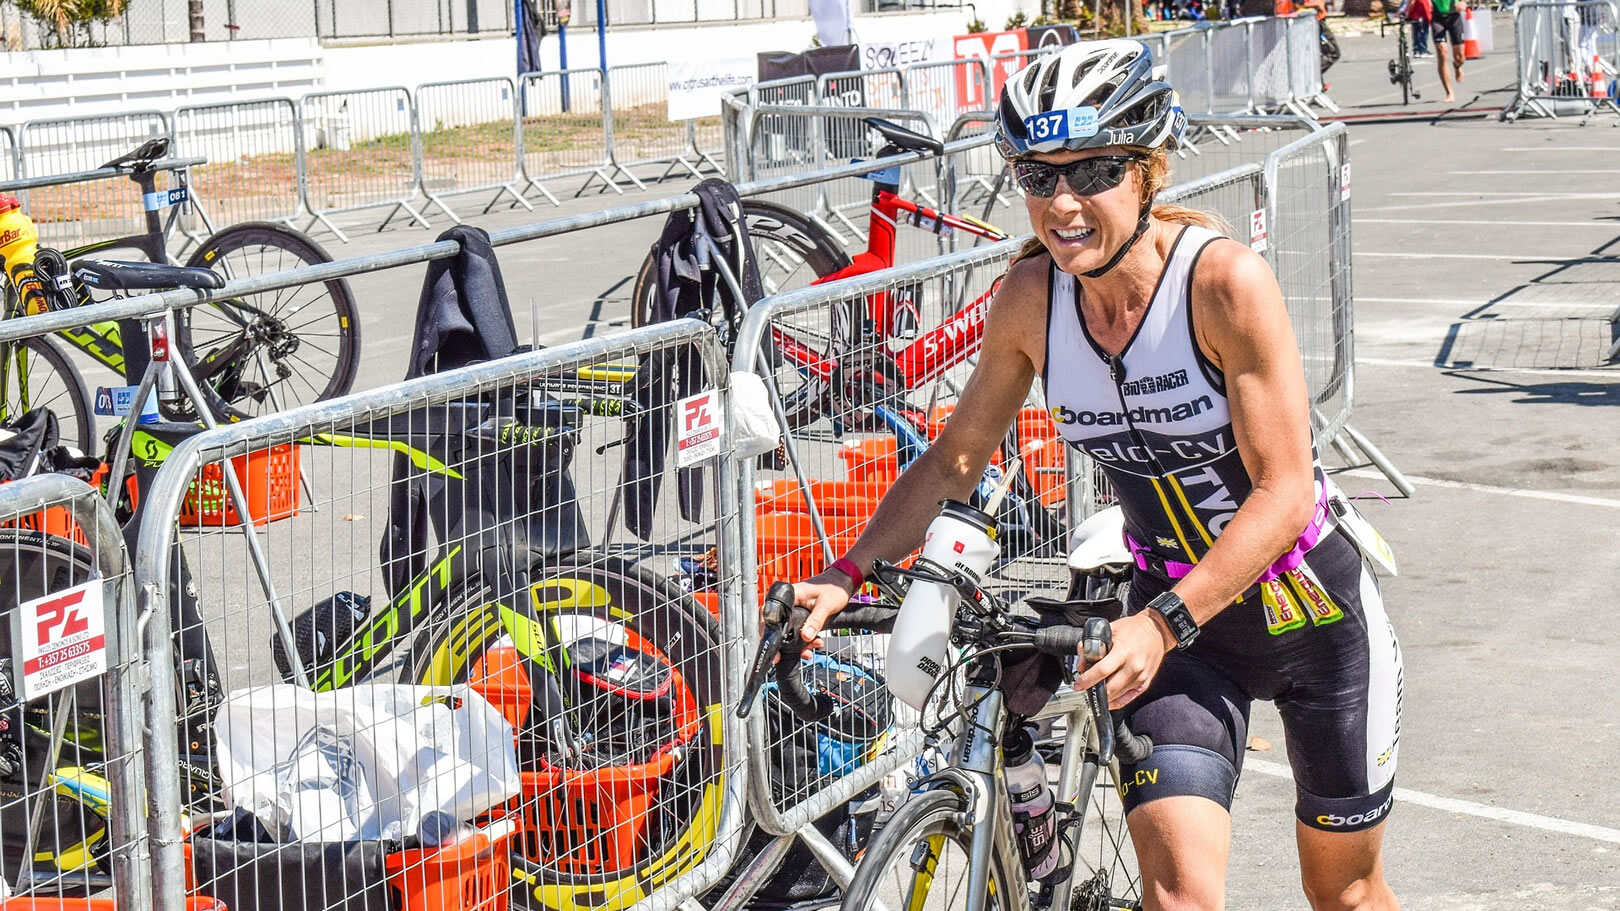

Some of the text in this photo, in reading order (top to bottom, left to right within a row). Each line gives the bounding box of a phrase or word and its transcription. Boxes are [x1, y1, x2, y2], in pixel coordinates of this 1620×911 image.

[1026, 114, 1063, 140] 137
[1106, 130, 1135, 145] Julia
[1056, 394, 1213, 426] boardman
[0, 534, 51, 546] ONTINENTAL
[36, 590, 88, 646] PZ
[60, 649, 68, 660] 25
[1122, 768, 1159, 796] o-CV
